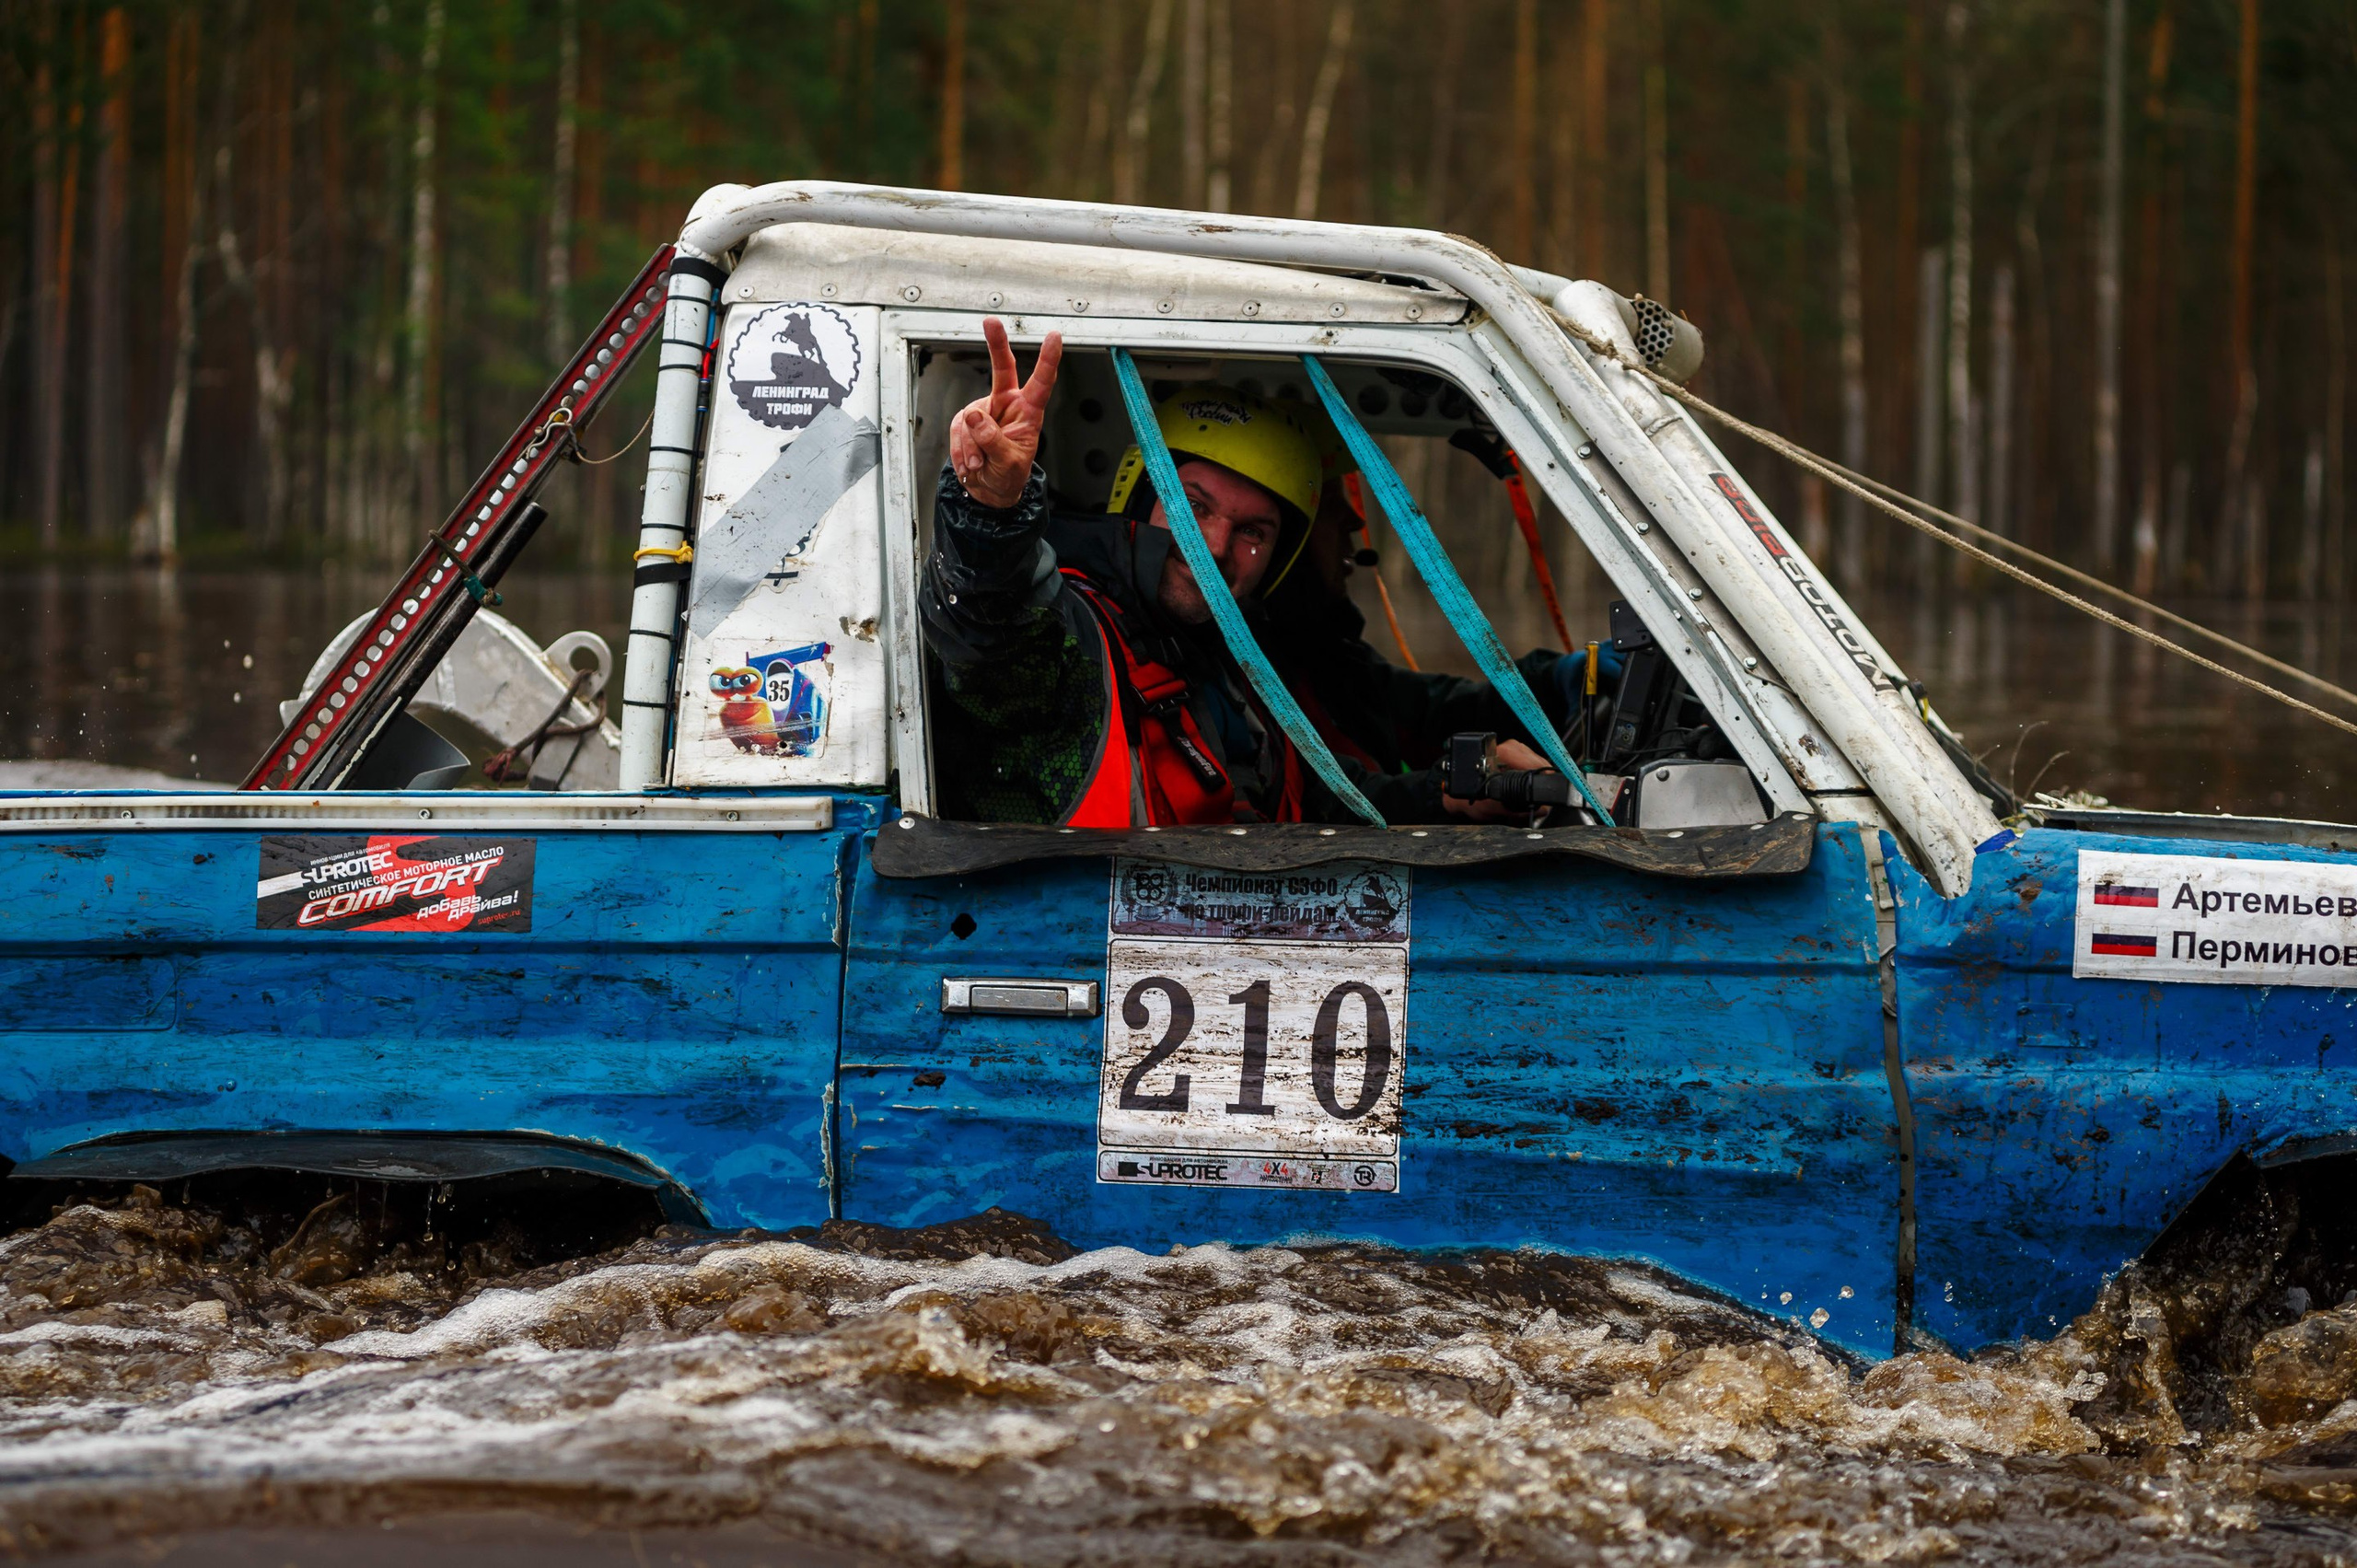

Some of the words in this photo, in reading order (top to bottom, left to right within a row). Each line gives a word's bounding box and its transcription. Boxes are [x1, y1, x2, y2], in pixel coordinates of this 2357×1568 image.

[752, 385, 829, 400] ЛЕНИНГРАД
[766, 402, 812, 415] ТРОФИ
[768, 679, 790, 703] 35
[343, 850, 355, 858] ДЛЯ
[302, 851, 394, 884] SUPROTEC
[308, 869, 401, 900] СИНТЕТИЧЕСКОЕ
[403, 855, 463, 877] МОТОРНОЕ
[464, 846, 505, 864] МАСЛО
[297, 857, 502, 925] COMFORT
[1185, 873, 1283, 895] Чемпионат
[1288, 877, 1338, 897] СЗФО
[416, 894, 482, 921] добавь
[447, 889, 519, 922] драйва!
[2171, 881, 2357, 918] Артемьев
[1209, 902, 1338, 923] трофи-рейдам
[1119, 976, 1392, 1121] 210
[1137, 1163, 1228, 1180] SUPROTEC
